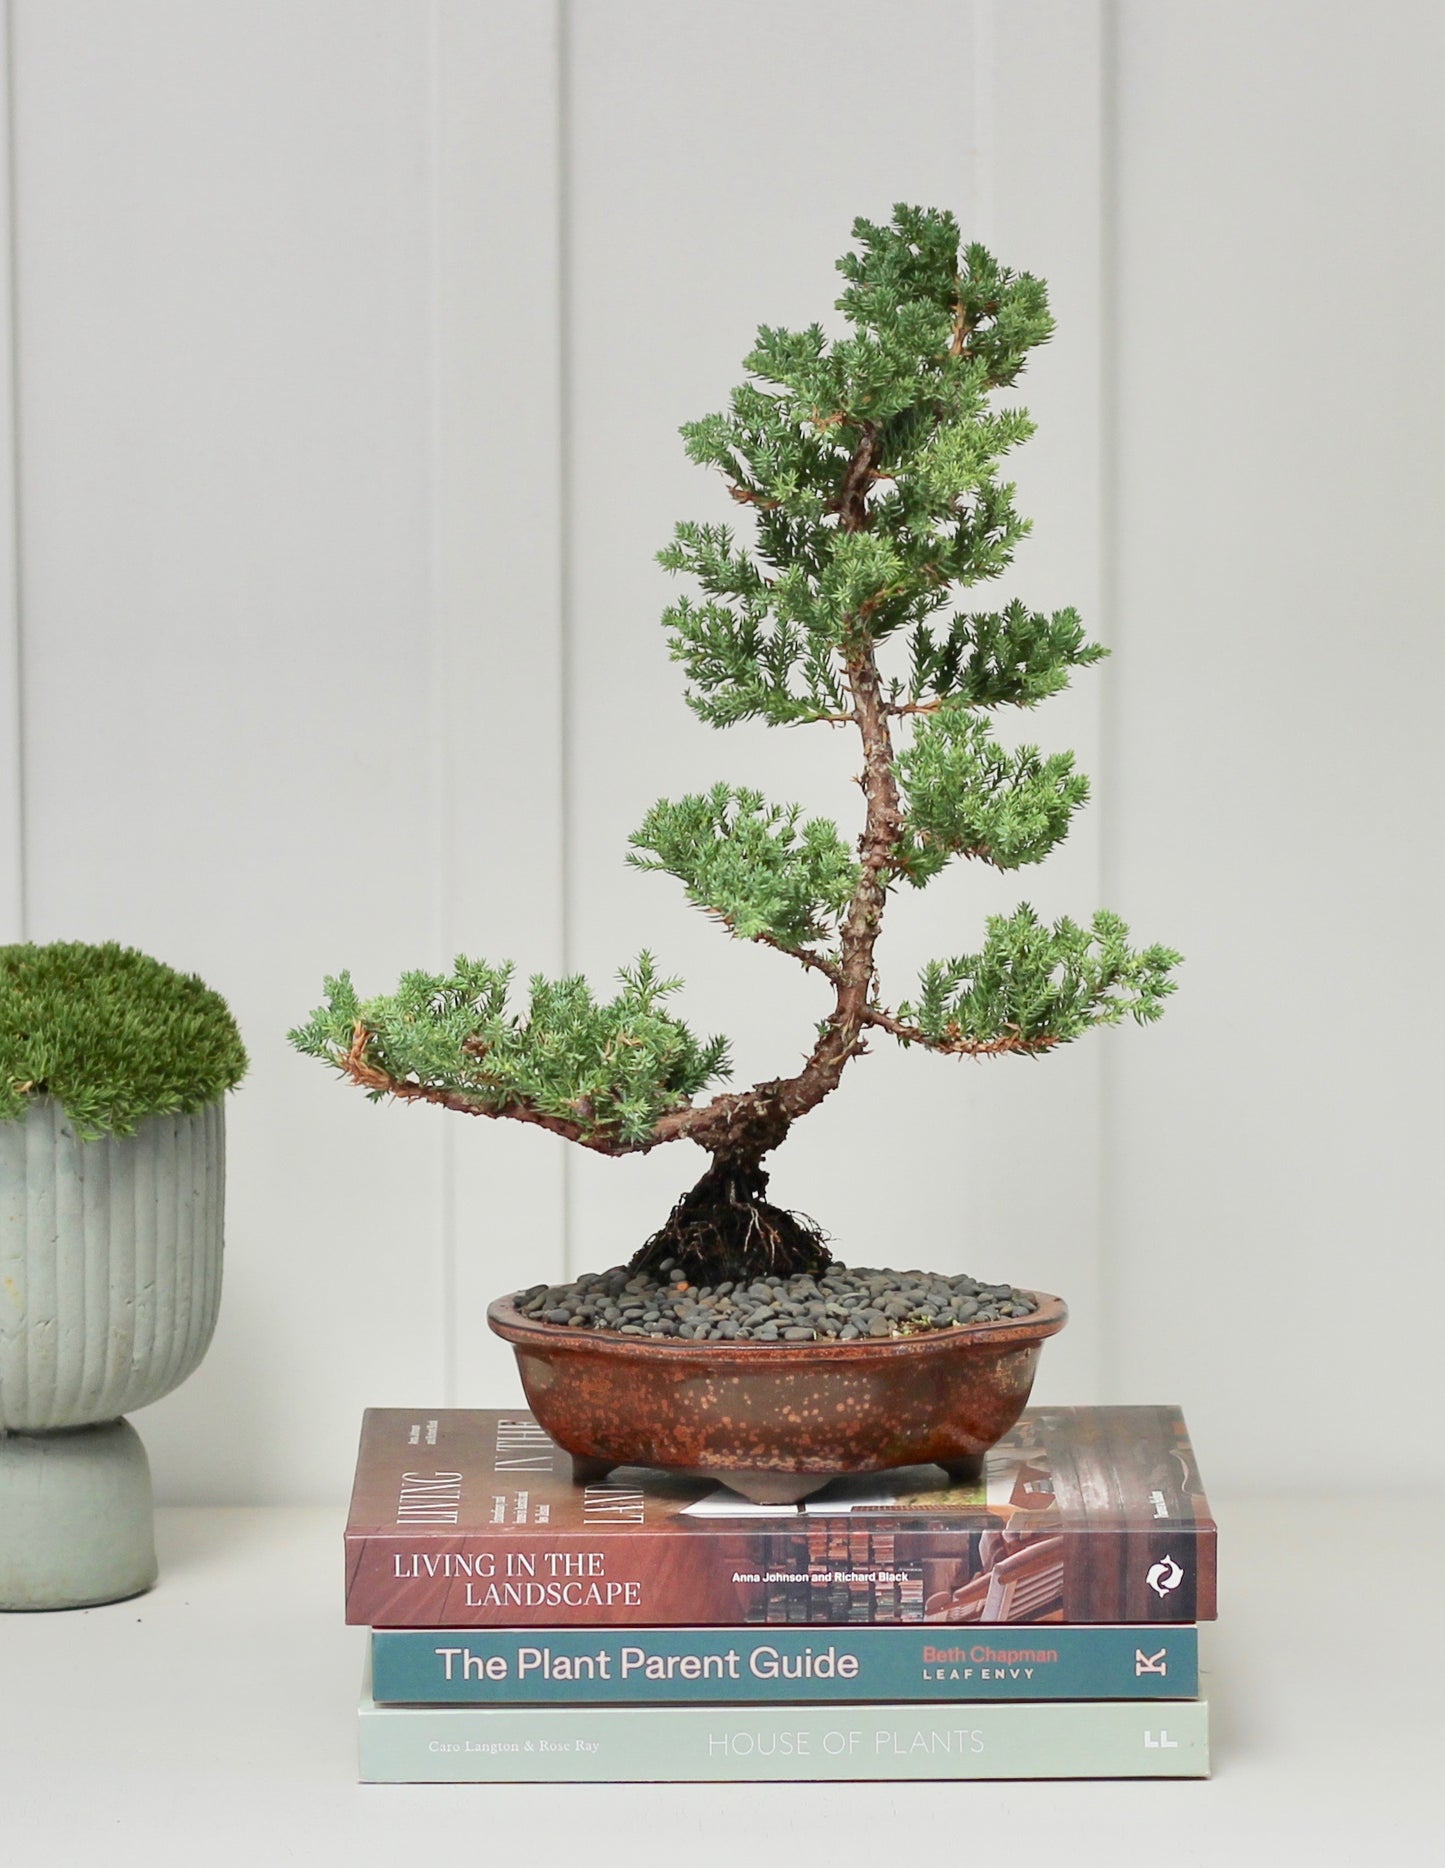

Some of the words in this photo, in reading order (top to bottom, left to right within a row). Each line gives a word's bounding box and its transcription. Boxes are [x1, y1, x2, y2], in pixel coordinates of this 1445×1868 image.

[494, 1455, 553, 1472] IN
[396, 1471, 463, 1524] LIVING
[394, 1553, 495, 1577] LIVING
[506, 1553, 536, 1577] IN
[544, 1553, 605, 1577] THE
[732, 1572, 760, 1582] Anna
[762, 1571, 809, 1582] Johnson
[811, 1571, 832, 1582] and
[834, 1571, 876, 1582] Richard
[878, 1571, 909, 1582] Black
[465, 1582, 641, 1606] LANDSCAPE
[435, 1648, 508, 1680] The
[518, 1648, 612, 1680] Plant
[621, 1647, 741, 1679] Parent
[749, 1646, 859, 1679] Guide
[923, 1645, 967, 1664] Beth
[970, 1645, 1059, 1666] Chapman
[923, 1668, 973, 1680] LEAF
[981, 1668, 1035, 1680] ENVY
[428, 1740, 461, 1753] Caro
[465, 1740, 519, 1755] Langton
[523, 1740, 534, 1752] &
[539, 1739, 570, 1752] Rose
[575, 1739, 600, 1754] Ray
[708, 1731, 810, 1757] HOUSE
[822, 1731, 863, 1755] OF
[875, 1729, 985, 1754] PLANTS
